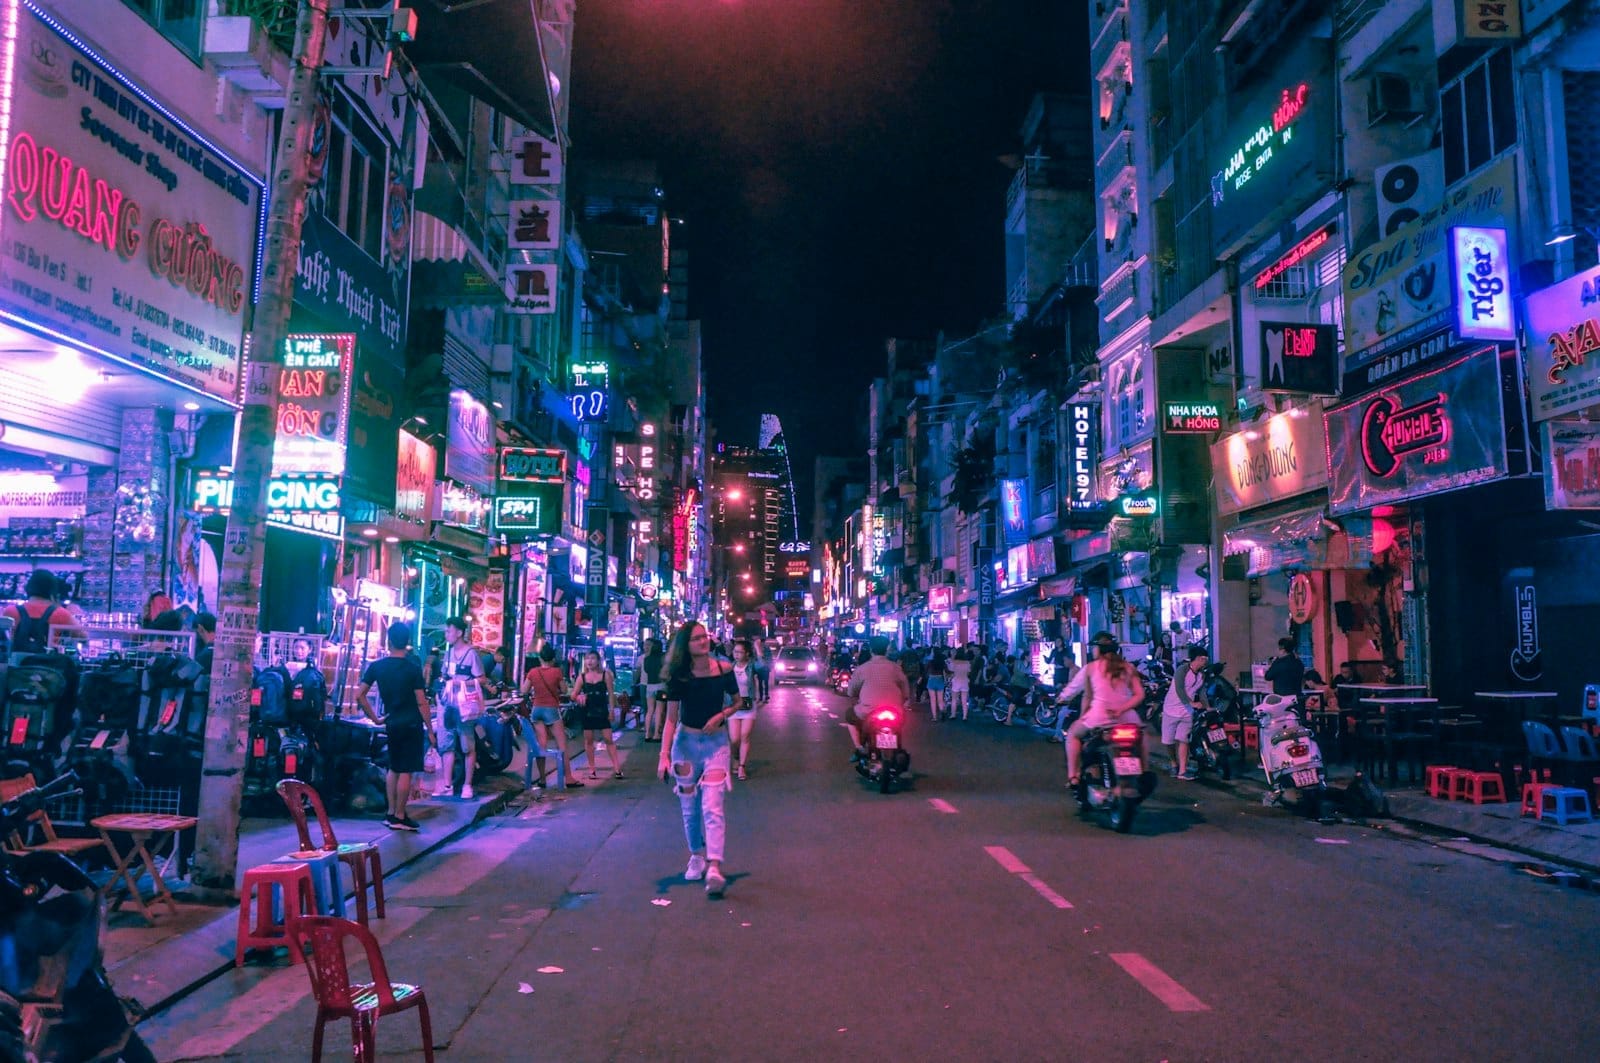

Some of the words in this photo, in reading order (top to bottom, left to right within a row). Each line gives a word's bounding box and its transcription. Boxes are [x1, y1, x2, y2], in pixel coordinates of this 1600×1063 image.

[8, 132, 142, 262] QUANG
[1467, 246, 1504, 322] Tiger
[296, 338, 322, 353] PHÊ
[1169, 405, 1189, 416] NHA
[1192, 405, 1218, 416] KHOA
[500, 500, 534, 516] SPA
[588, 548, 604, 586] BIDV
[981, 577, 993, 605] BIDV
